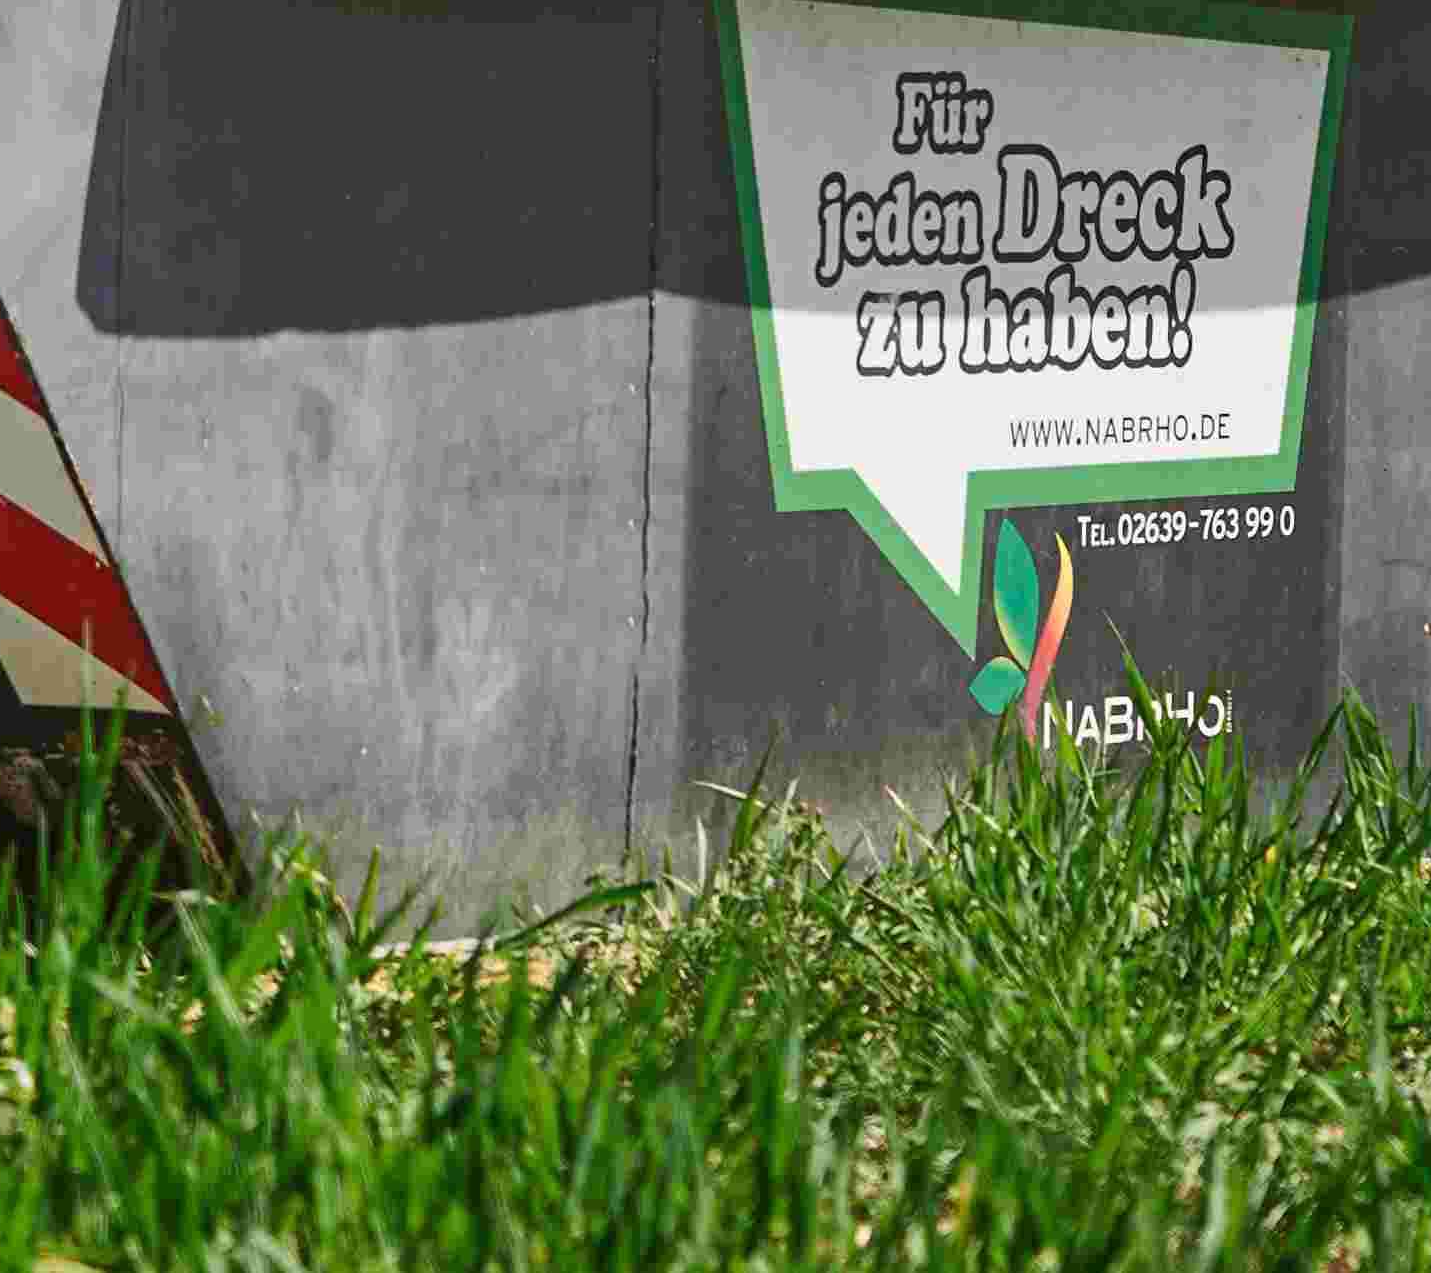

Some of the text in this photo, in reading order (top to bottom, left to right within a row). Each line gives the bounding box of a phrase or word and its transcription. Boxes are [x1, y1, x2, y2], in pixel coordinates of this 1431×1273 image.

[893, 71, 994, 154] Für
[816, 144, 1234, 286] jeden Dreck
[857, 259, 1196, 376] zu haben!
[1009, 412, 1231, 448] WWW.NABRHO.DE
[1117, 507, 1240, 546] 02639-763
[1245, 506, 1274, 538] 99
[1279, 505, 1296, 536] 0
